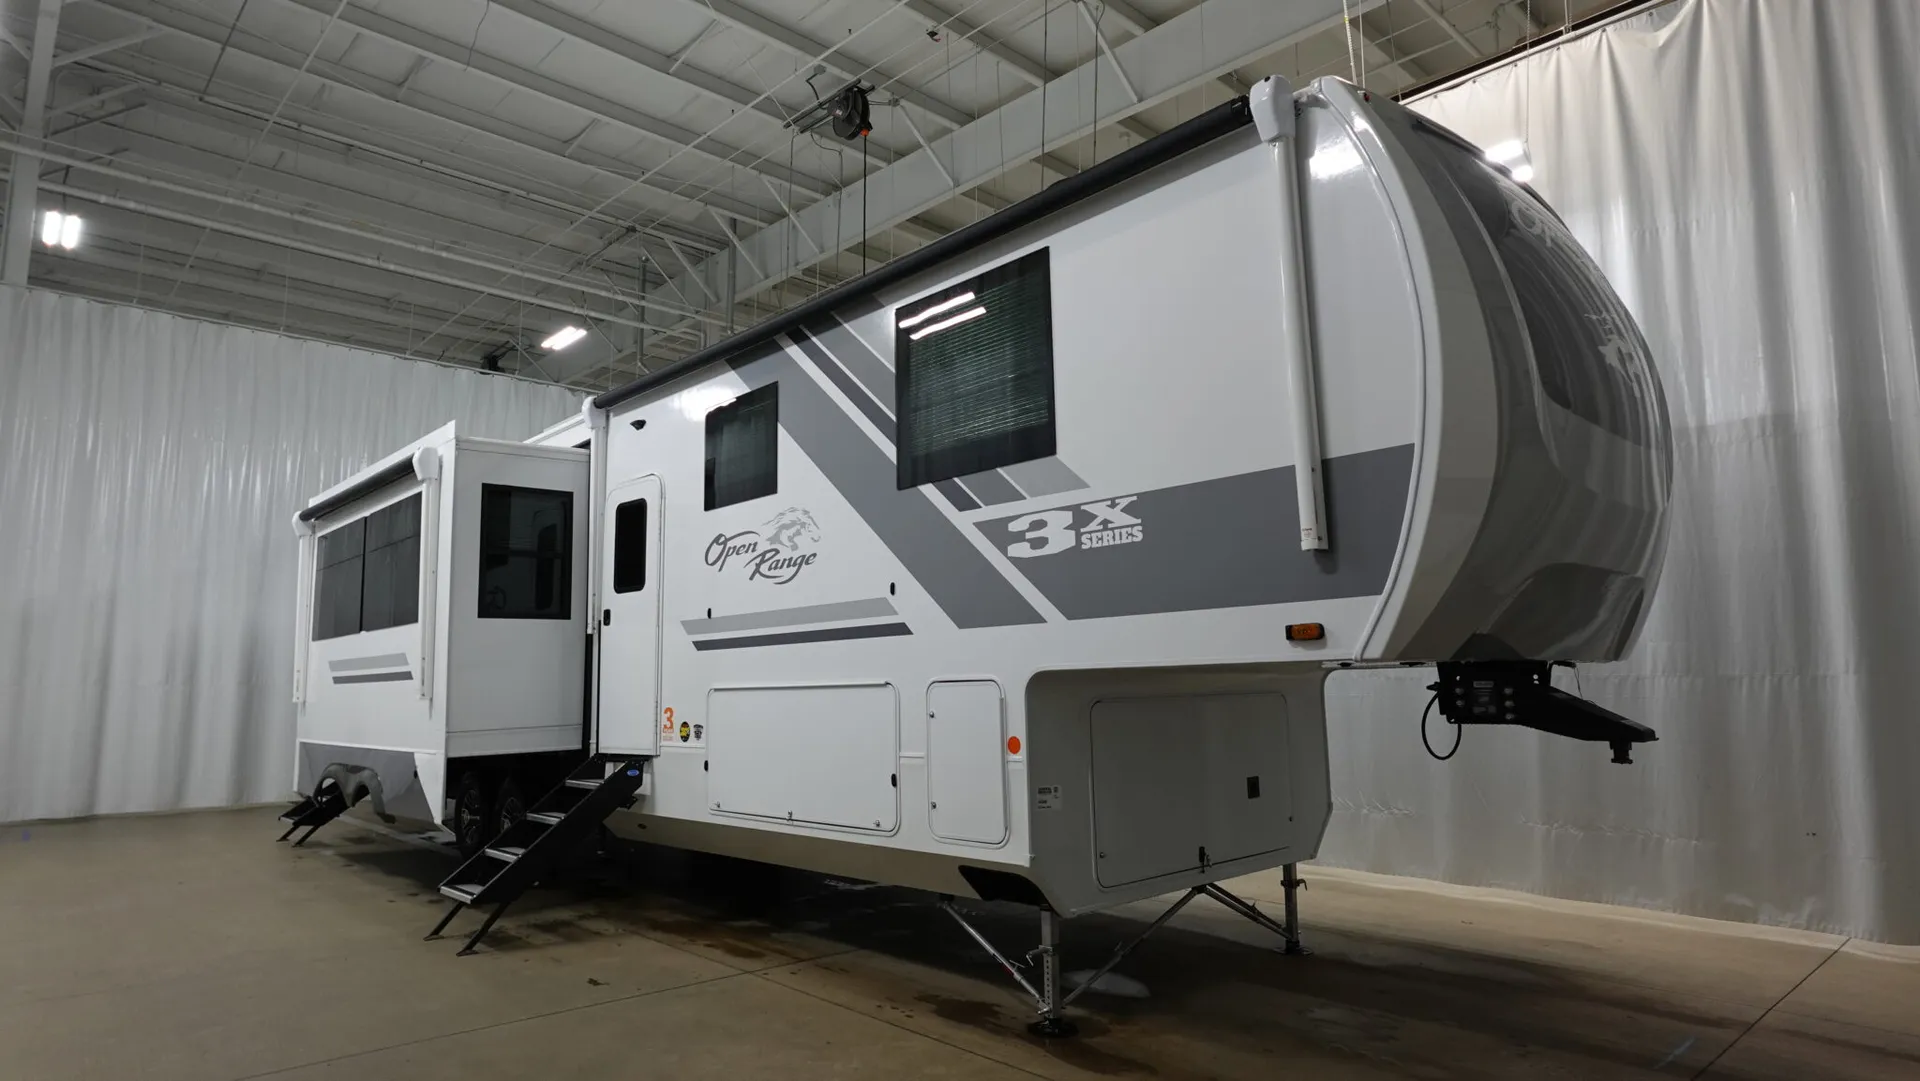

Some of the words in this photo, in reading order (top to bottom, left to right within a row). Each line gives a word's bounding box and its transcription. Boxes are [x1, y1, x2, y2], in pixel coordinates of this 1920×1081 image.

[704, 530, 760, 572] Open
[1081, 525, 1143, 550] SERIES
[743, 547, 818, 585] Range
[663, 706, 674, 729] 3
